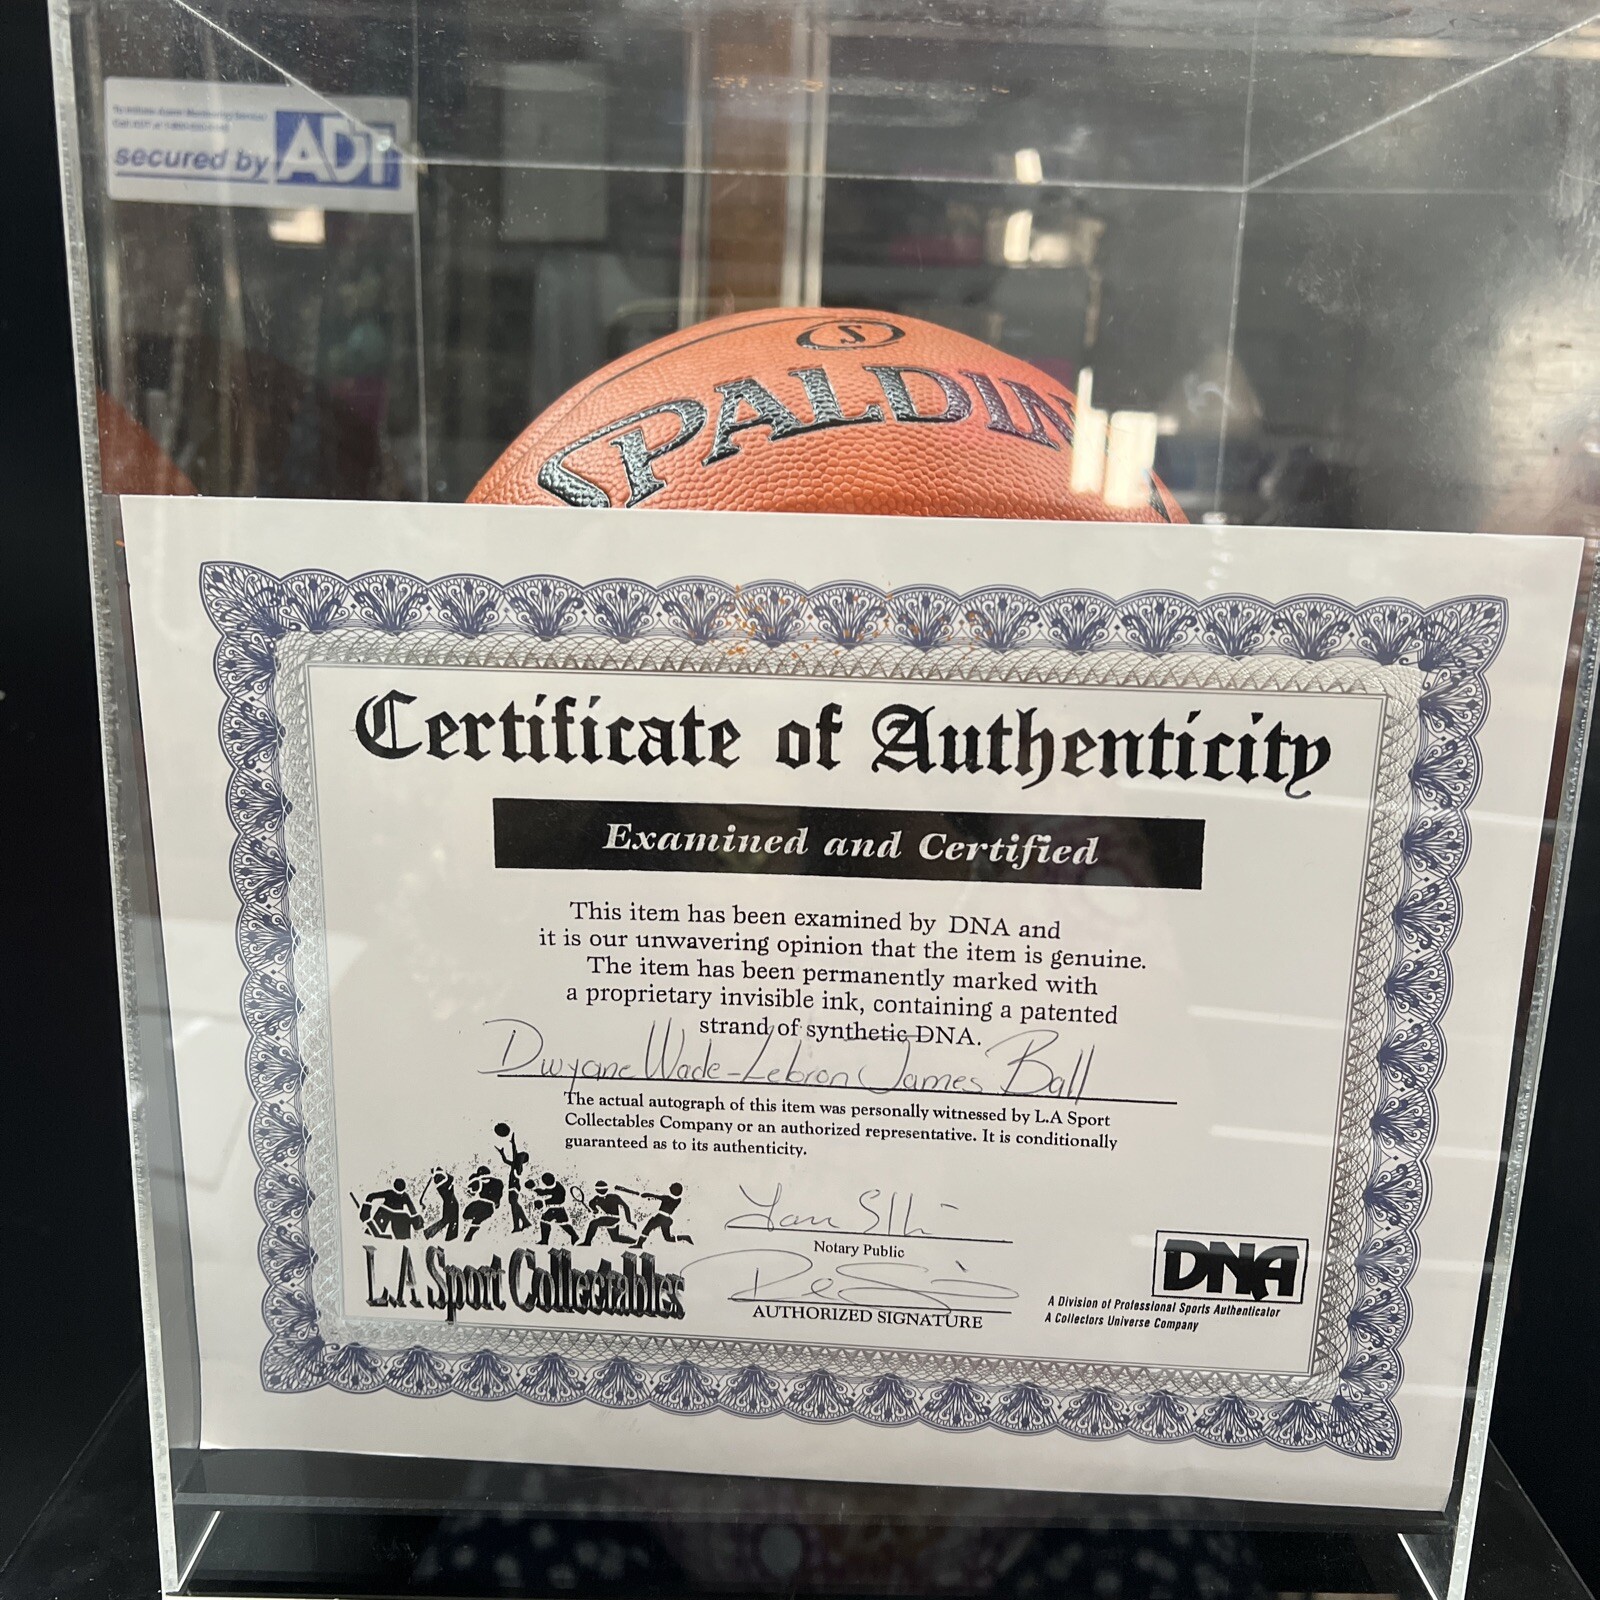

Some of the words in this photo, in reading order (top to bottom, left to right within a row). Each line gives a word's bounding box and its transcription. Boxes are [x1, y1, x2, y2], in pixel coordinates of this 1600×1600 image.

[114, 147, 227, 171] secured
[235, 151, 269, 180] by
[276, 111, 400, 190] ADT
[536, 363, 1172, 523] SPALDIN
[355, 689, 741, 769] Certificate
[776, 702, 843, 770] of
[871, 703, 1332, 800] Authenticity
[602, 822, 809, 857] Examined
[823, 831, 902, 859] and
[918, 832, 1099, 871] Certified
[570, 901, 622, 920] This
[629, 902, 679, 922] item
[688, 903, 725, 924] has
[733, 905, 786, 925] been
[794, 909, 901, 931] examined
[909, 912, 936, 934] by
[949, 915, 1010, 936] DNA
[1019, 921, 1061, 939] and
[539, 928, 556, 946] it
[563, 928, 581, 947] is
[589, 933, 628, 947] our
[636, 931, 769, 956] unwavering
[777, 935, 863, 958] opinion
[871, 939, 916, 959] that
[924, 941, 958, 960] the
[966, 942, 1016, 963] item
[1025, 945, 1043, 964] is
[1050, 949, 1147, 970] genuine.
[587, 956, 632, 975] The
[639, 957, 689, 977] item
[697, 959, 735, 978] has
[742, 960, 795, 980] been
[803, 966, 945, 991] permanently
[953, 972, 1038, 992] marked
[1046, 975, 1099, 996] with
[566, 987, 578, 1001] a
[586, 983, 712, 1009] proprietary
[720, 986, 814, 1009] invisible
[822, 991, 866, 1015] ink,
[873, 995, 993, 1022] containing
[1000, 1004, 1012, 1018] a
[1020, 1003, 1118, 1025] patented
[699, 1016, 769, 1036] strand
[777, 1018, 801, 1036] of
[806, 1020, 908, 1043] synthetic
[915, 1025, 982, 1046] DNA.
[856, 1036, 984, 1094] James
[985, 1029, 1095, 1105] Ball
[564, 1091, 594, 1107] The
[599, 1093, 644, 1108] actual
[648, 1095, 726, 1113] autograph
[730, 1097, 745, 1111] of
[749, 1098, 777, 1112] this
[781, 1099, 815, 1114] item
[820, 1104, 846, 1115] was
[851, 1103, 930, 1121] personally
[933, 1106, 1007, 1123] witnessed
[1011, 1108, 1031, 1125] by
[1034, 1109, 1062, 1125] L.A
[1067, 1111, 1111, 1128] Sport
[564, 1112, 655, 1129] Collectables
[659, 1115, 733, 1133] Company
[737, 1121, 753, 1132] or
[757, 1121, 777, 1133] an
[781, 1121, 860, 1137] authorized
[865, 1126, 978, 1143] representative.
[982, 1129, 995, 1143] It
[1000, 1130, 1011, 1144] is
[1016, 1131, 1118, 1151] conditionally
[564, 1136, 648, 1150] guaranteed
[652, 1140, 667, 1150] as
[672, 1139, 687, 1151] to
[691, 1138, 708, 1151] its
[713, 1140, 807, 1158] authenticity.
[813, 1240, 860, 1258] Notary
[863, 1243, 905, 1258] Public
[425, 1245, 506, 1325] Sport
[509, 1247, 686, 1320] Collectables
[1163, 1238, 1300, 1301] DNA
[752, 1304, 873, 1323] AUTHORIZED
[877, 1311, 983, 1329] SIGNATURE
[1044, 1312, 1051, 1323] A
[1054, 1313, 1104, 1326] Collectors
[1107, 1316, 1150, 1328] Universe
[1153, 1318, 1199, 1332] Company
[1047, 1295, 1055, 1306] A
[1057, 1296, 1099, 1309] Division
[1101, 1298, 1112, 1309] of
[1114, 1299, 1176, 1313] Professional
[1179, 1302, 1210, 1316] Sports
[1213, 1304, 1281, 1318] Authenticator
